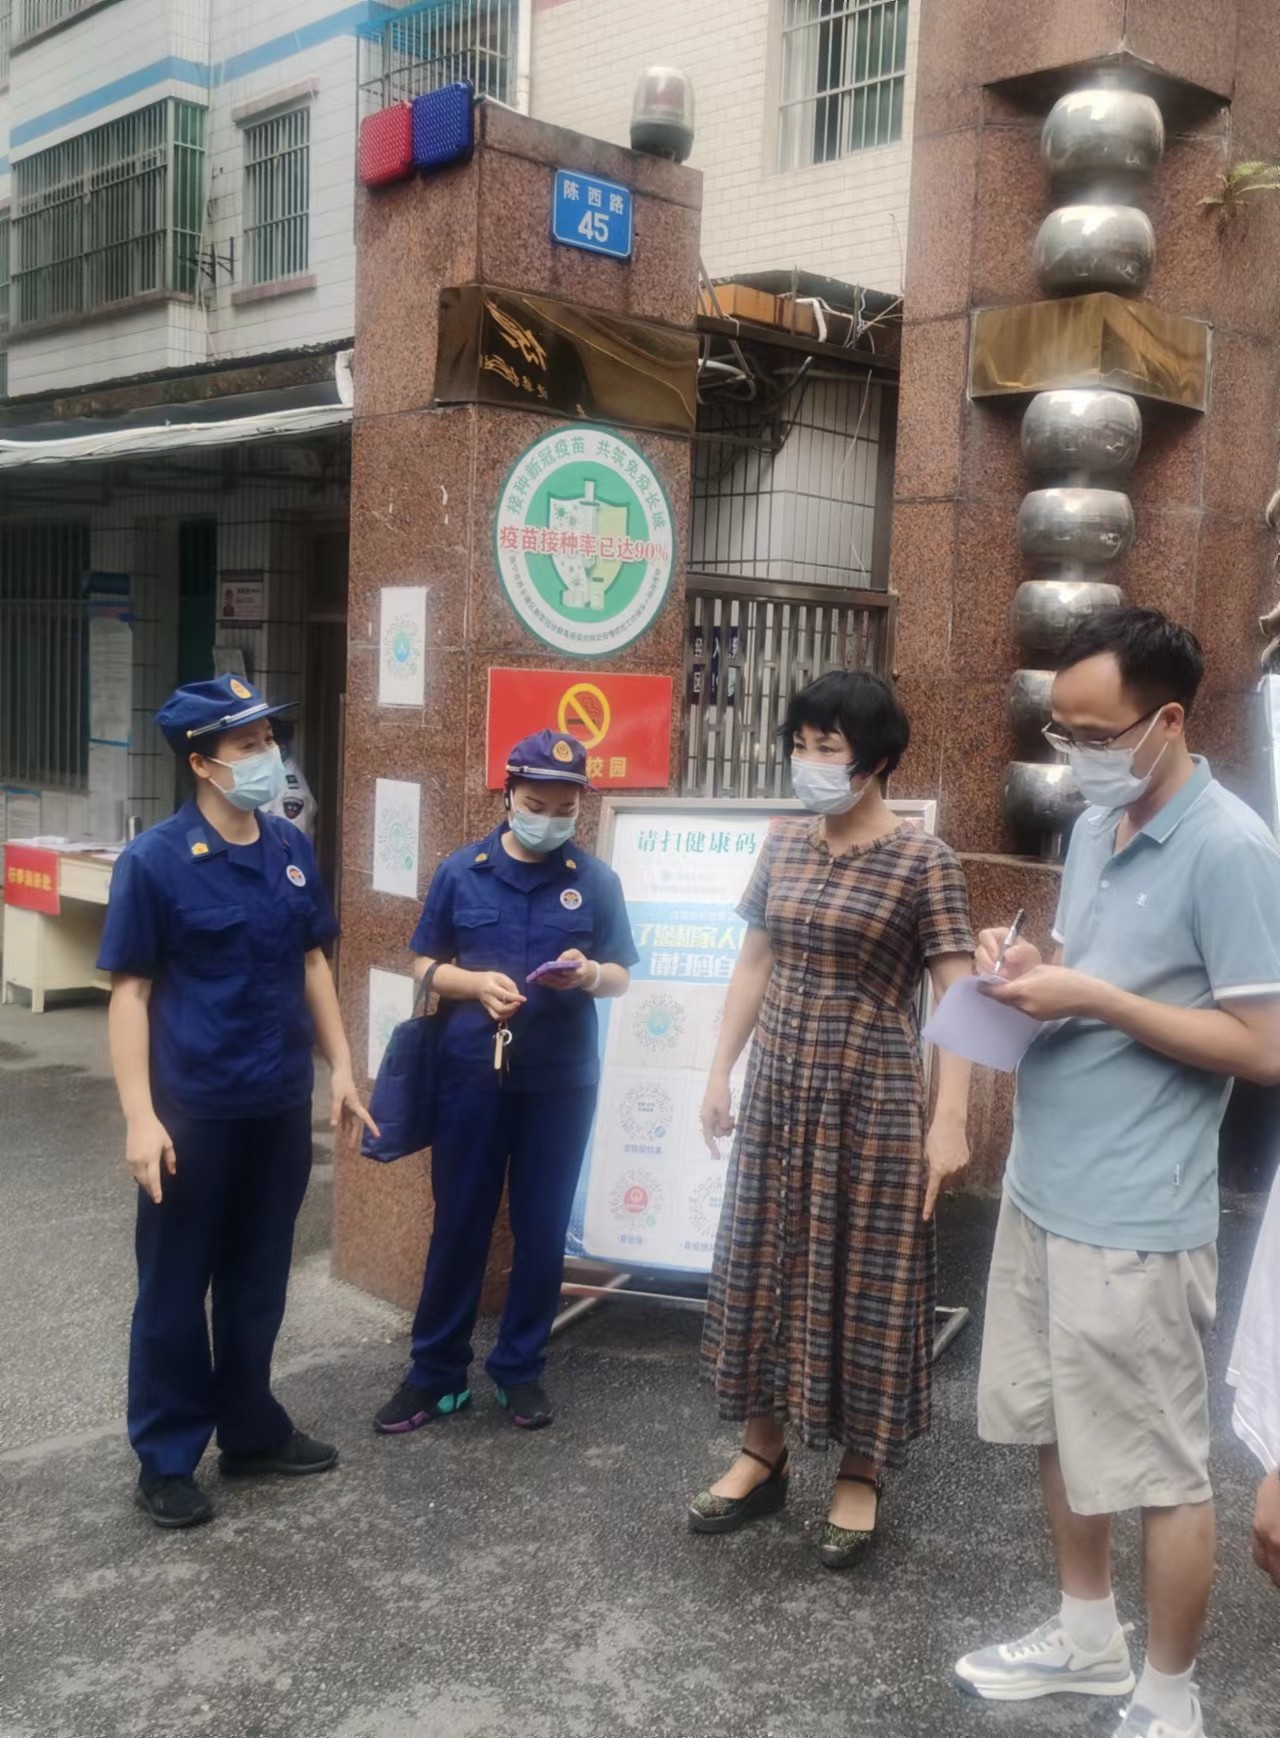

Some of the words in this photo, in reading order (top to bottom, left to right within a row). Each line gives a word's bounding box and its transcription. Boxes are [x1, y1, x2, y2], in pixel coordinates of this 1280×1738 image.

[563, 179, 624, 215] 陈西路
[578, 210, 609, 242] 45
[506, 436, 585, 515] 接种新冠疫苗
[596, 439, 666, 531] 共筑免疫长城
[500, 525, 669, 562] 疫苗接种率已达90%
[638, 829, 757, 855] 请扫健康码
